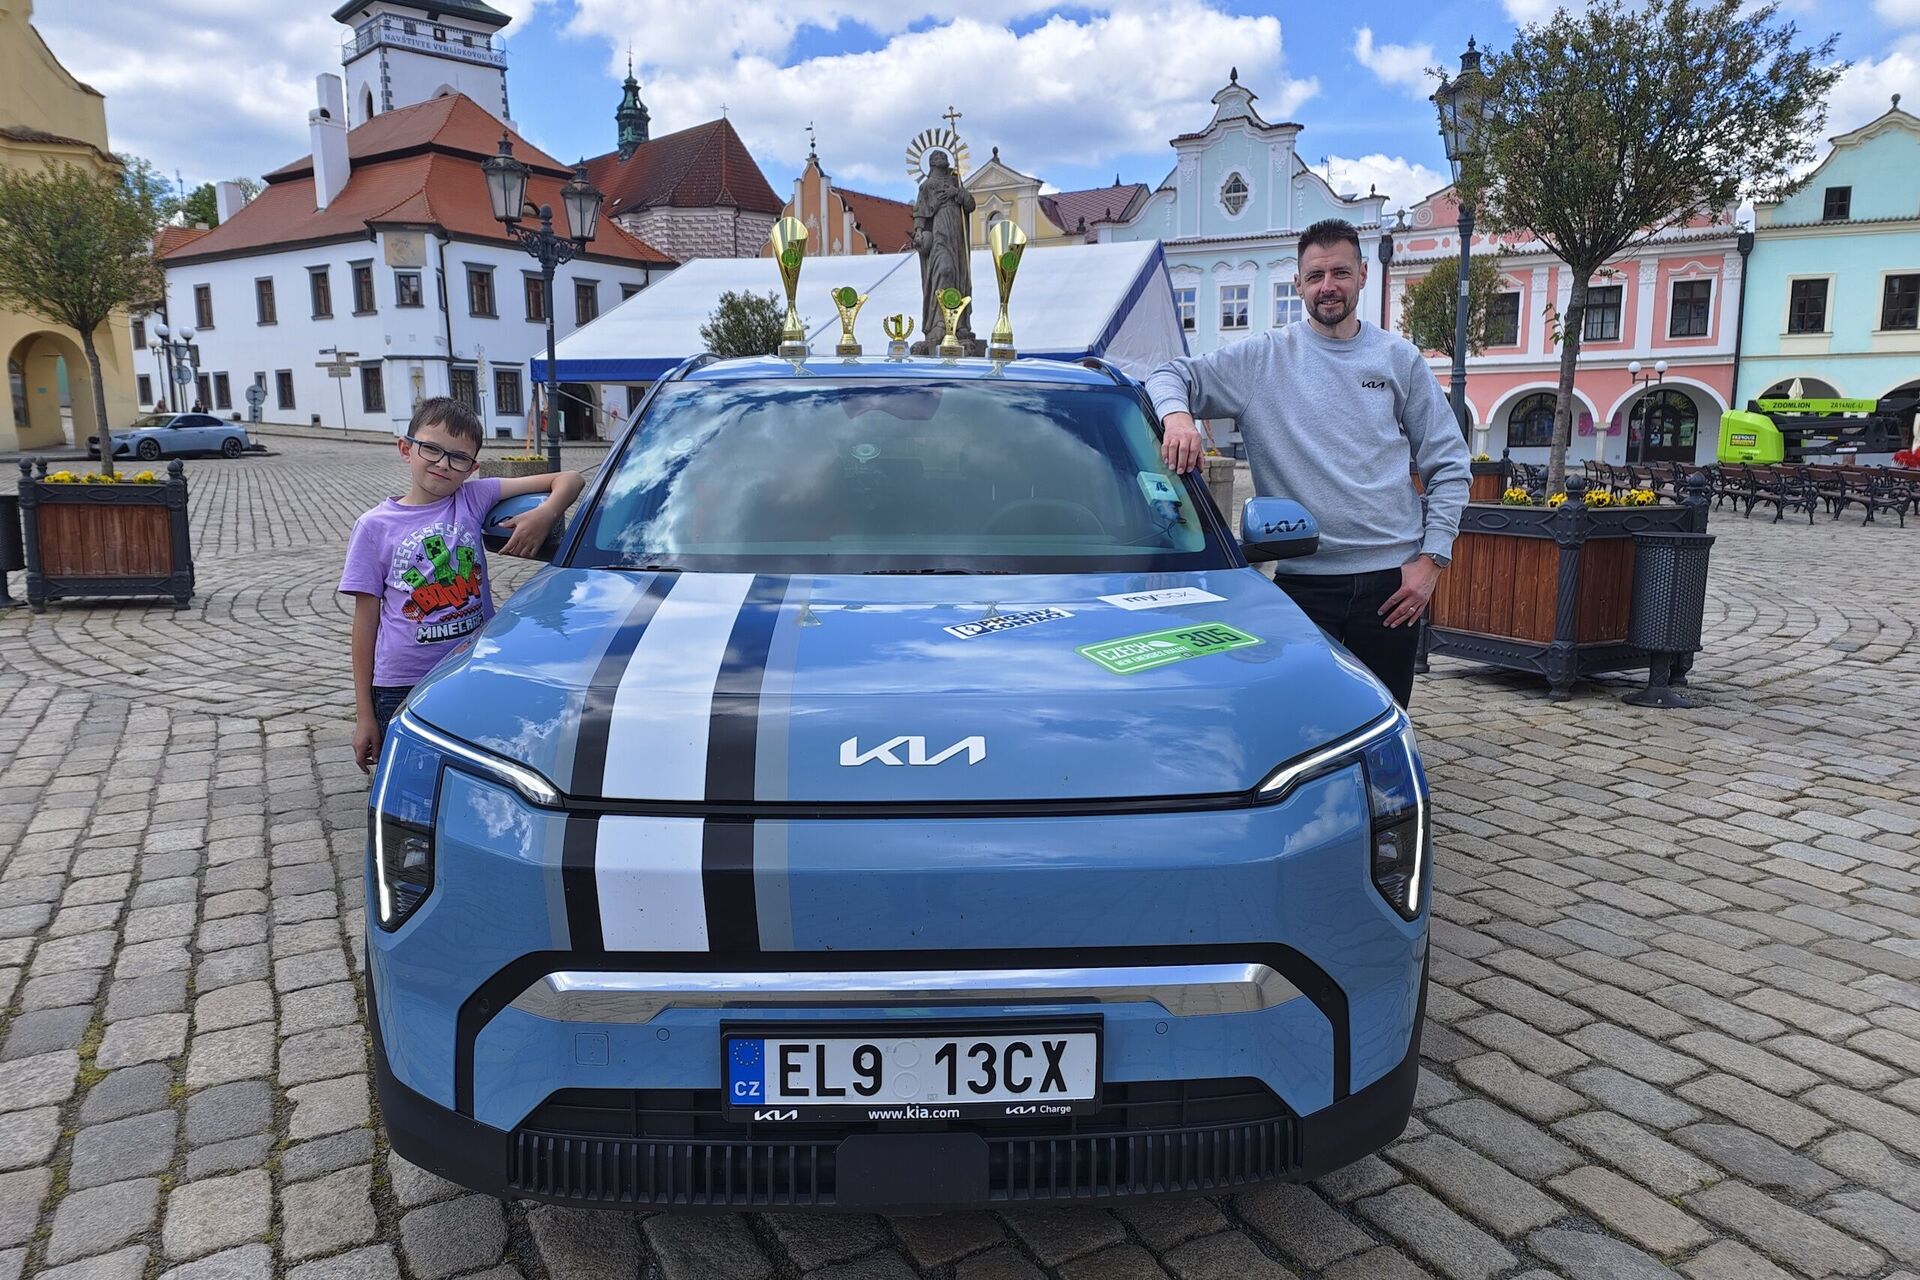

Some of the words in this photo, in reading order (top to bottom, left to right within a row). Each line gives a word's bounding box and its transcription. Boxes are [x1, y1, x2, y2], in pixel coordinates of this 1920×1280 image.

[384, 33, 432, 49] NAVŠTIVTE
[433, 44, 488, 61] VYHLÍDKOVOU
[1362, 381, 1385, 389] KIA
[1264, 518, 1307, 535] KIA
[411, 574, 481, 616] BOOM
[416, 614, 484, 641] MINECRAF
[989, 612, 1066, 631] CONTACT
[1176, 628, 1242, 648] 305
[1097, 641, 1152, 661] CZECH
[1114, 657, 1134, 667] NEW
[840, 735, 987, 767] KIA
[779, 1043, 883, 1097] EL9
[934, 1040, 1068, 1096] 13CX
[734, 1080, 760, 1097] CZ
[754, 1109, 798, 1121] KIA
[868, 1105, 960, 1120] www.kia.com
[1005, 1106, 1037, 1116] KIA
[1039, 1103, 1072, 1116] Charge
